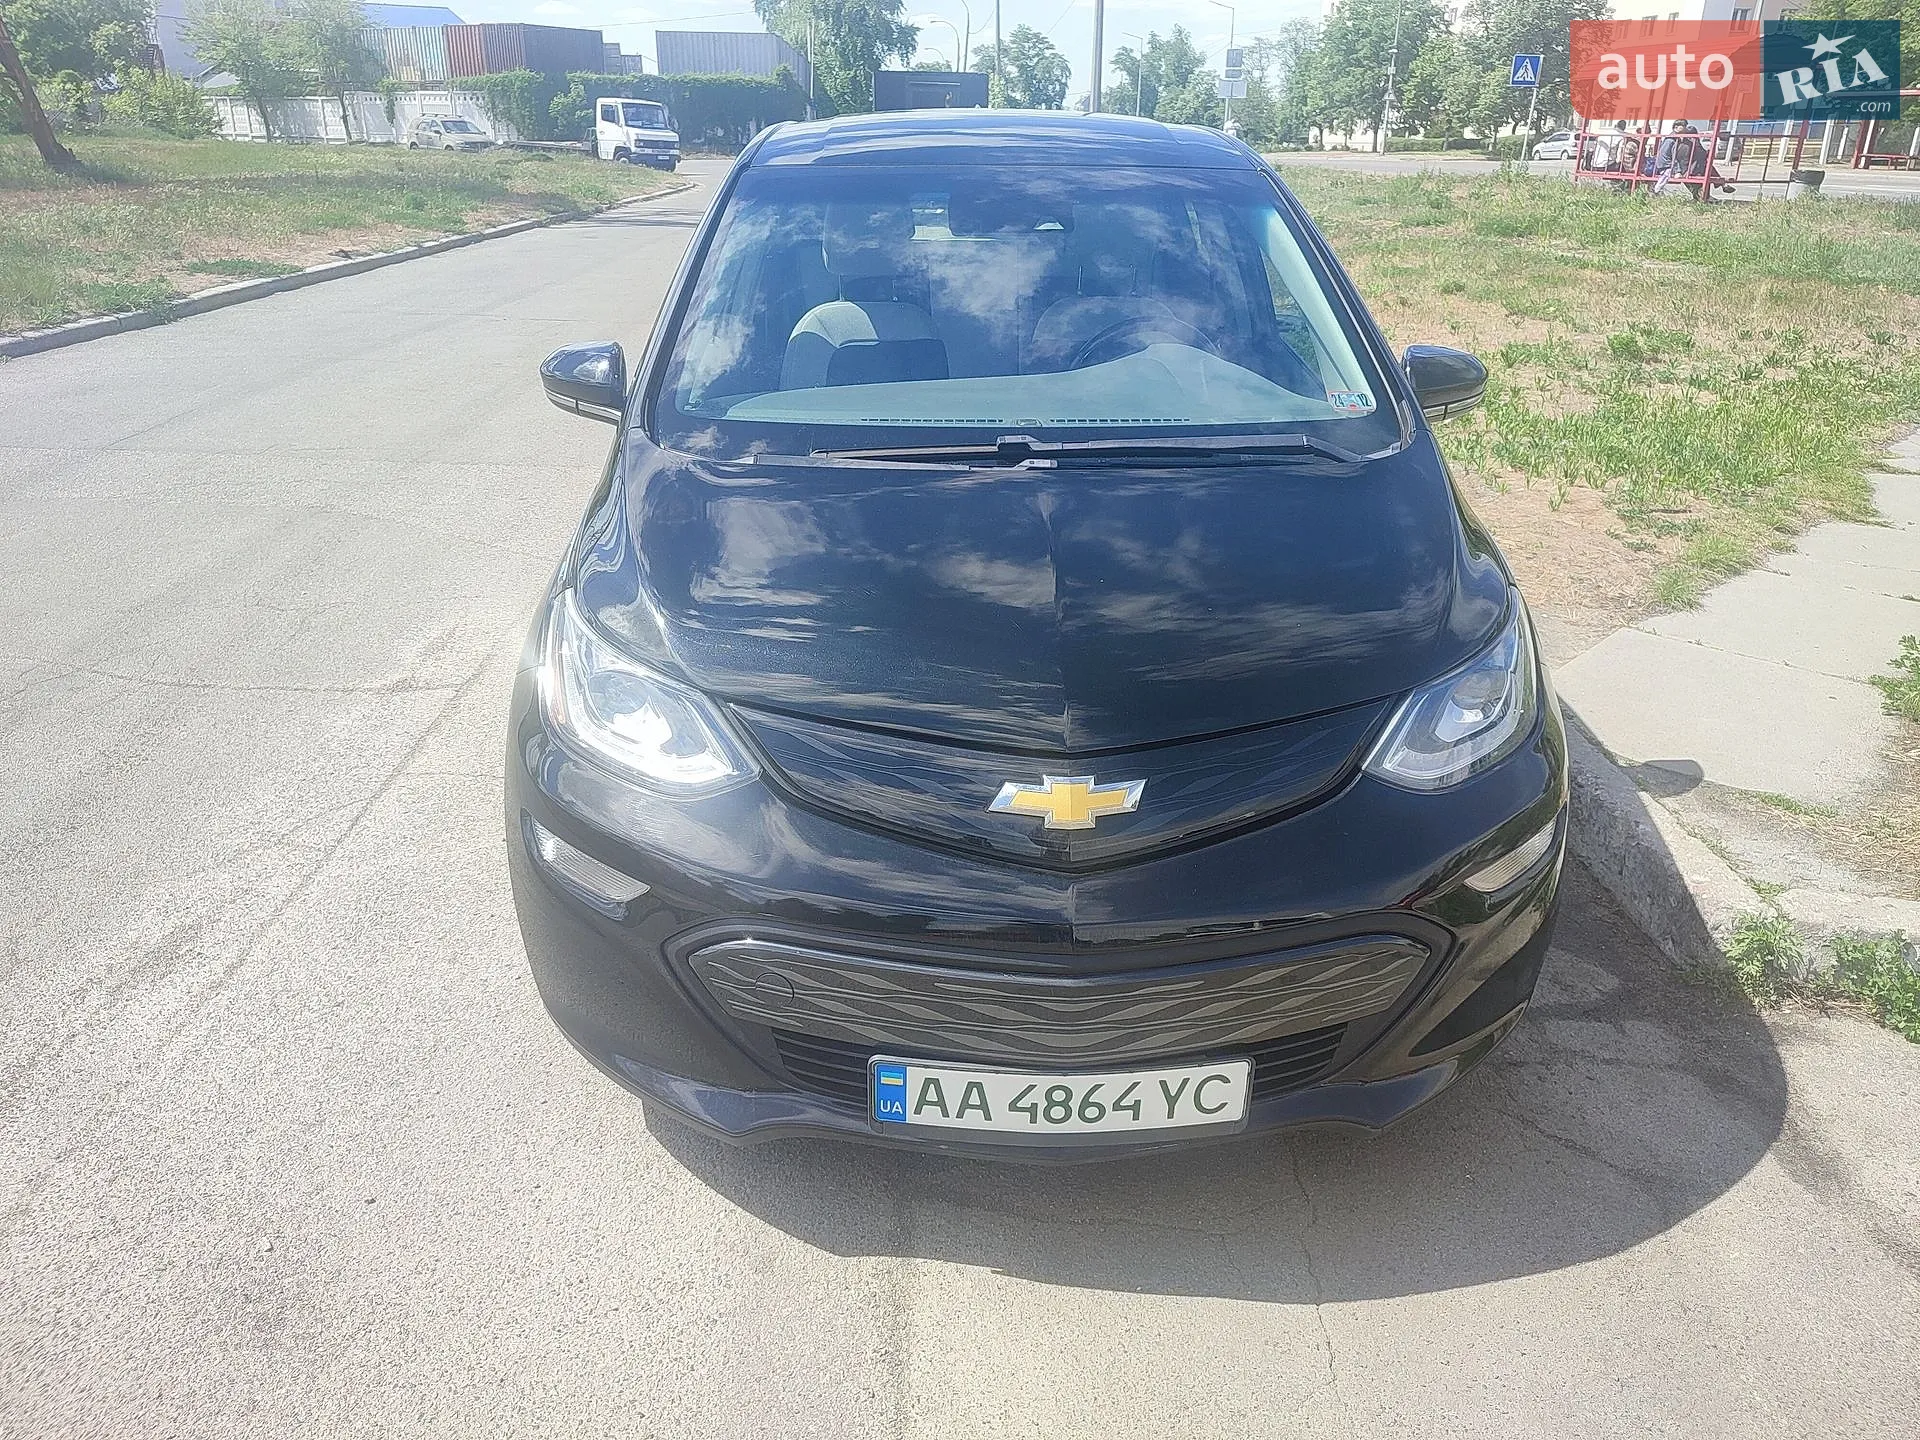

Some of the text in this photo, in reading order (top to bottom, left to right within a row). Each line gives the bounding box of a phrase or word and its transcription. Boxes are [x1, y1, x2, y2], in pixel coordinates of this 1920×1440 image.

[1357, 393, 1372, 408] 12
[880, 1099, 903, 1114] UA
[913, 1074, 1231, 1124] AA 4864 YC
